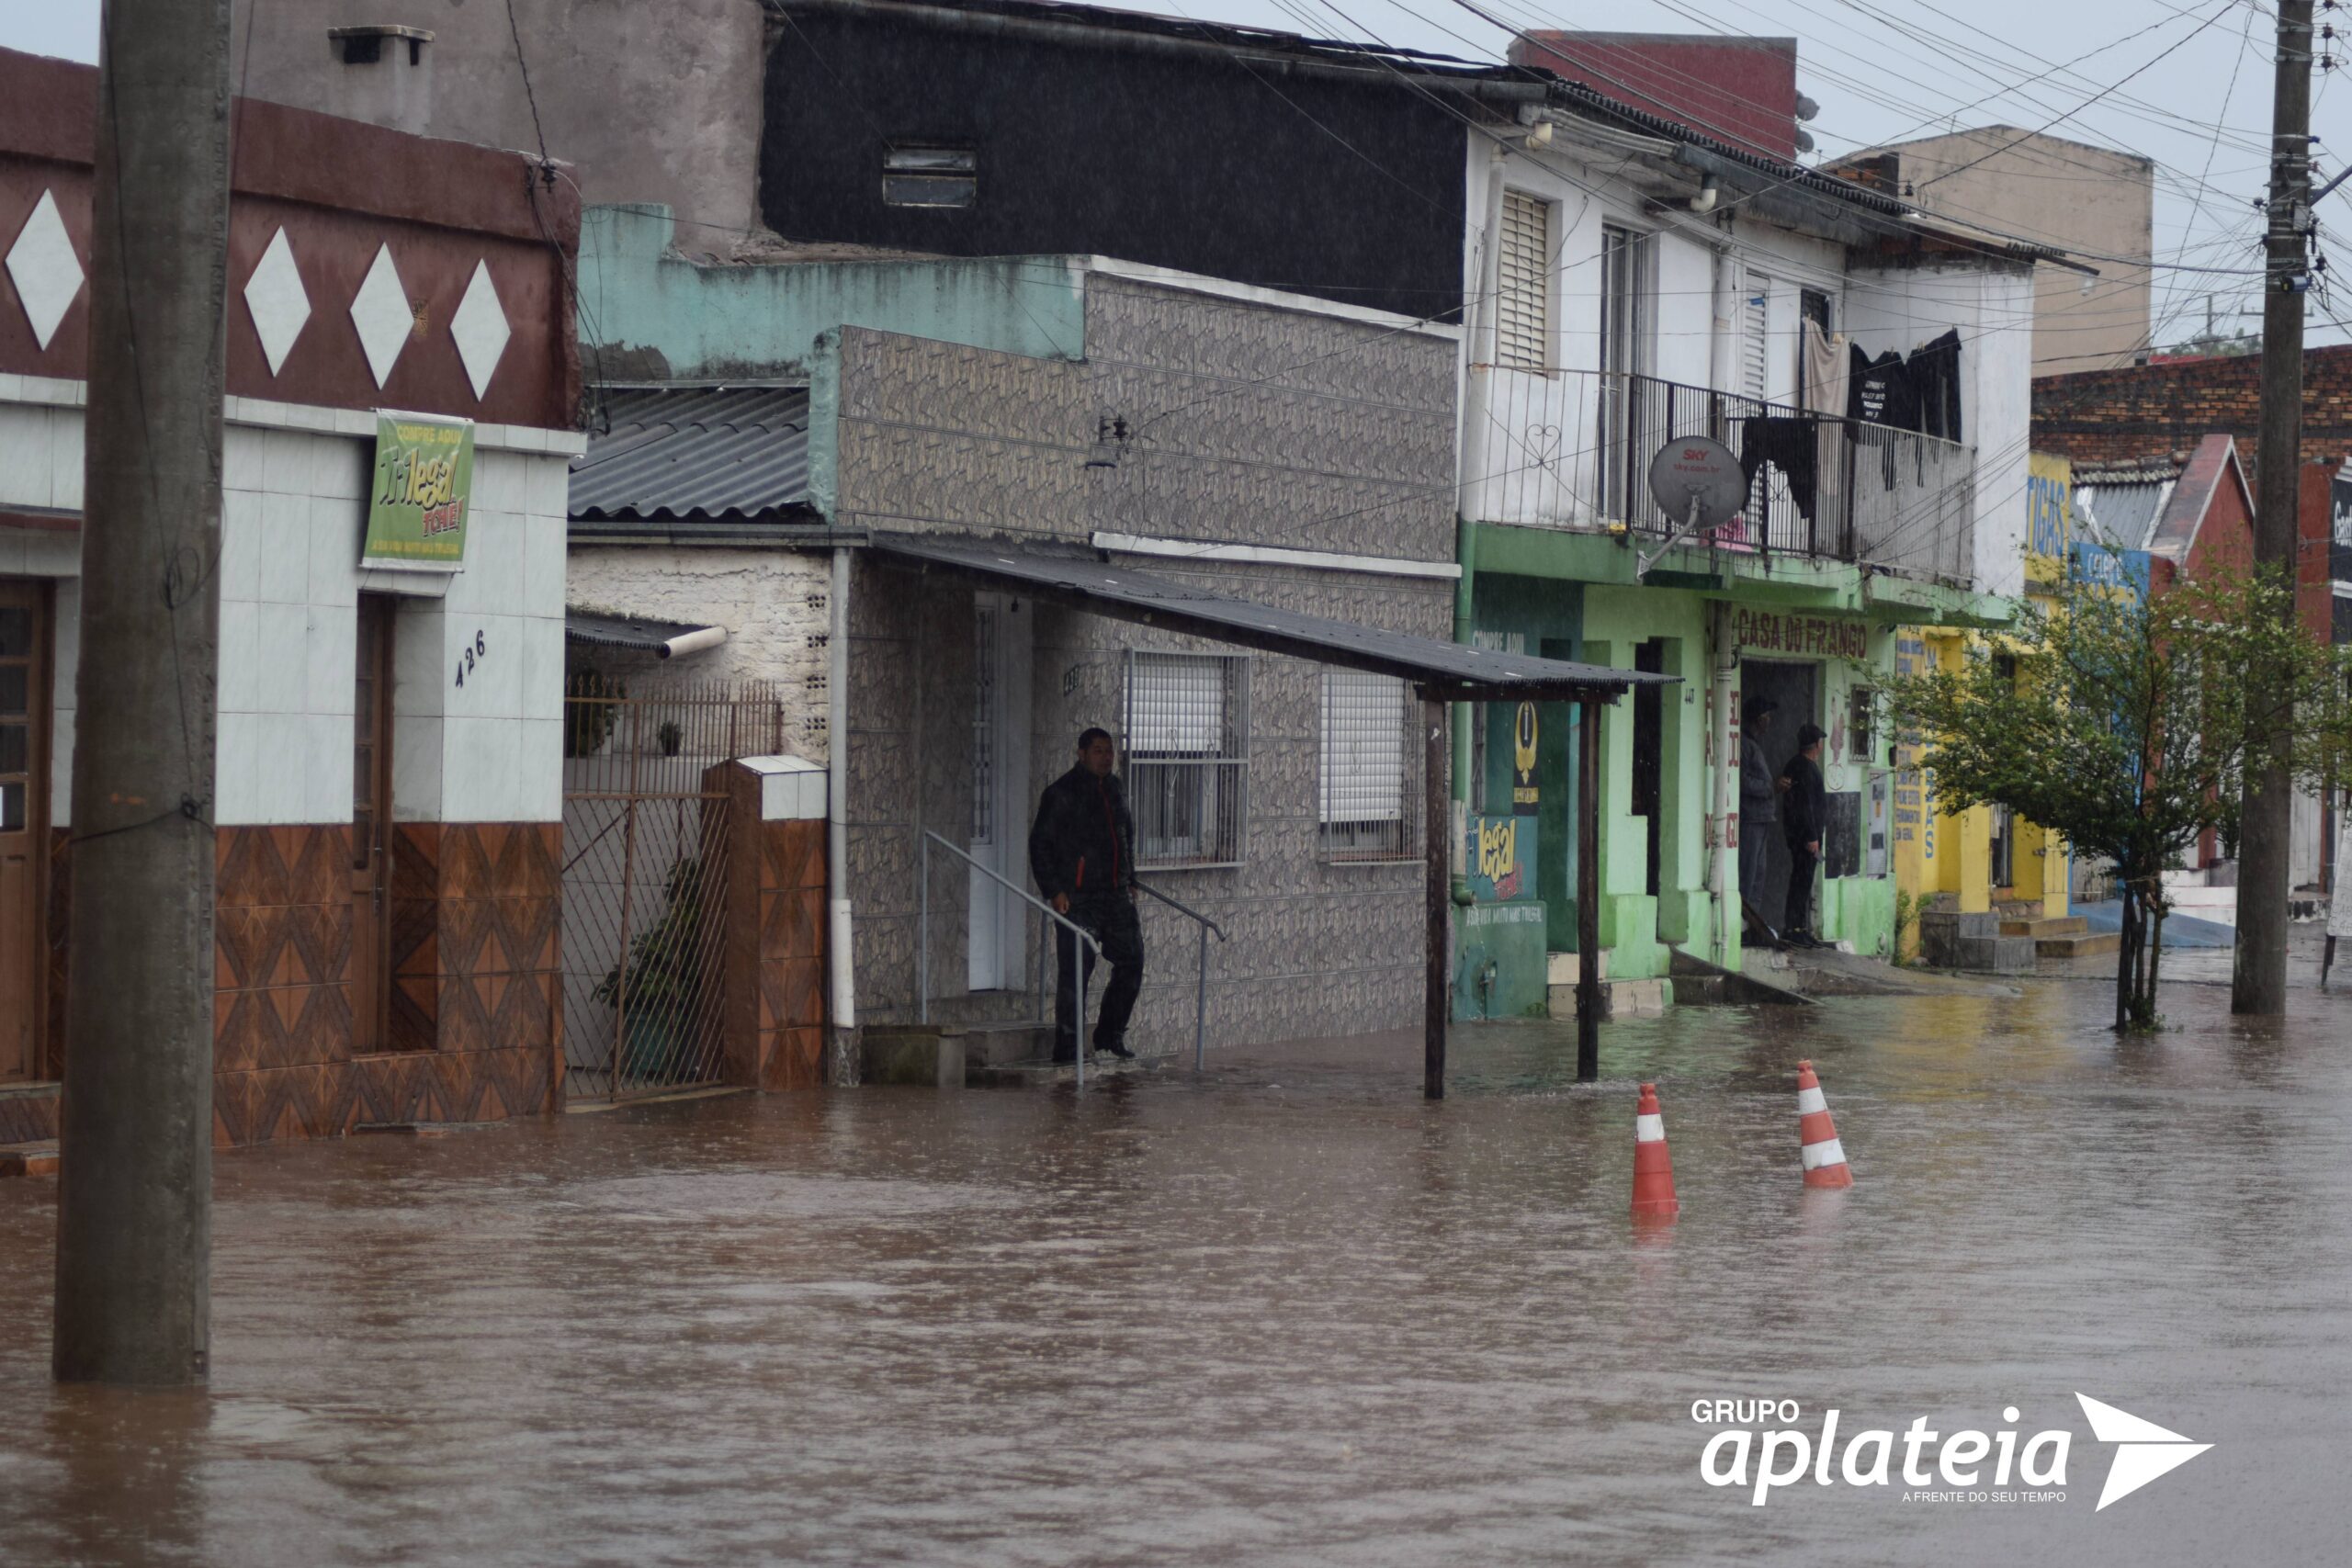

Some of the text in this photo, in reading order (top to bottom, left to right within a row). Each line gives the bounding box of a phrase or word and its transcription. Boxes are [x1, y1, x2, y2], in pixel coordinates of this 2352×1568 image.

[397, 425, 435, 441] COMPRE
[1683, 448, 1709, 461] SKY
[1739, 609, 1867, 659] CASA DO FRANGO
